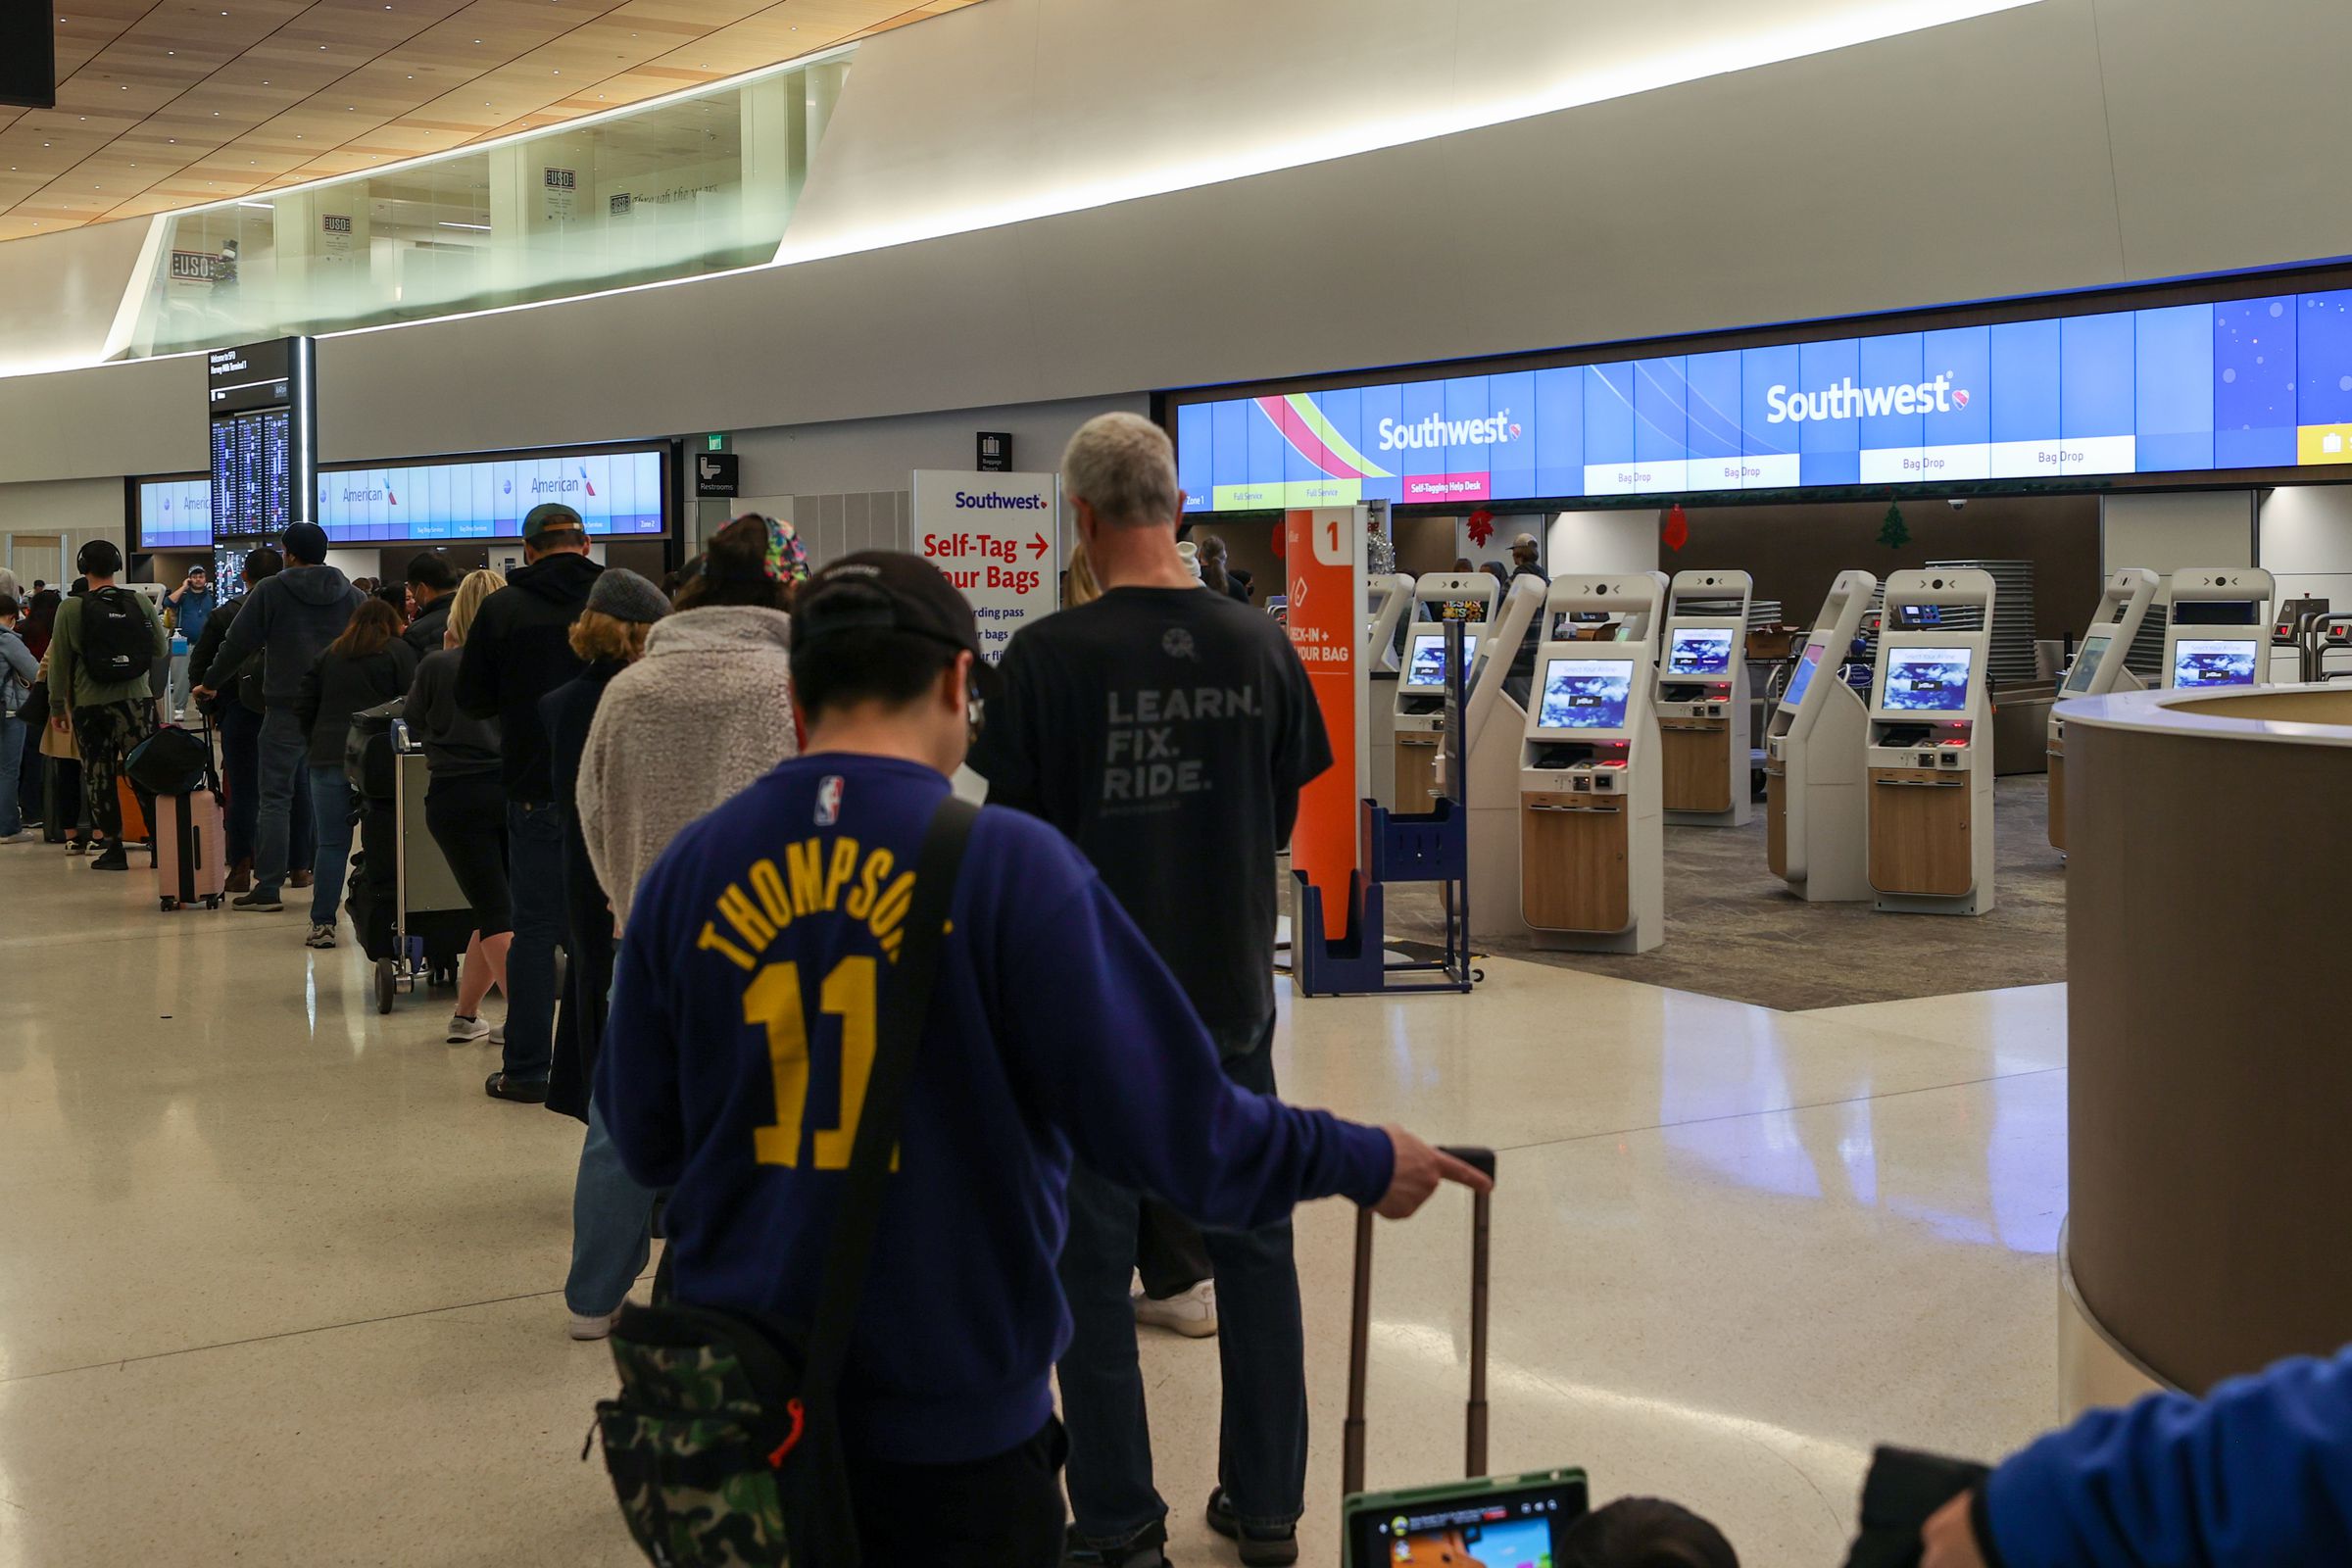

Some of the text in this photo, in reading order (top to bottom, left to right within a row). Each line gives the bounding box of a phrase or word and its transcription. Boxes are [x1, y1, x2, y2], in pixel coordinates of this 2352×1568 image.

[551, 171, 568, 186] USO
[614, 197, 627, 213] USO
[329, 218, 346, 231] USO
[180, 255, 209, 276] USO
[1767, 373, 1950, 423] Southwest
[1379, 411, 1508, 451] Southwest
[1903, 458, 1944, 470] Bag Drop
[2038, 451, 2083, 464] Bag Drop
[1618, 472, 1651, 485] Bag Drop
[1725, 466, 1761, 479] Bag Drop
[531, 477, 579, 494] American
[700, 482, 734, 491] Restrooms
[1320, 488, 1339, 497] Service
[1411, 480, 1481, 494] Self-Tagging Help Desk
[343, 487, 383, 503] American
[956, 491, 1040, 509] Southwest
[1187, 496, 1200, 506] Zone
[1233, 492, 1246, 501] Full
[640, 519, 651, 528] Zone
[1326, 520, 1338, 552] 1
[924, 533, 1017, 564] Self-Tag
[940, 565, 1040, 595] our Bags
[973, 608, 1024, 620] rding pass
[985, 629, 1008, 642] bags
[1322, 647, 1348, 662] BAG
[1107, 684, 1262, 723] LEARN.
[1106, 726, 1181, 763] FIX.
[1102, 760, 1213, 801] RIDE.
[696, 836, 953, 971] THOMPSO
[742, 955, 900, 1172] 11
